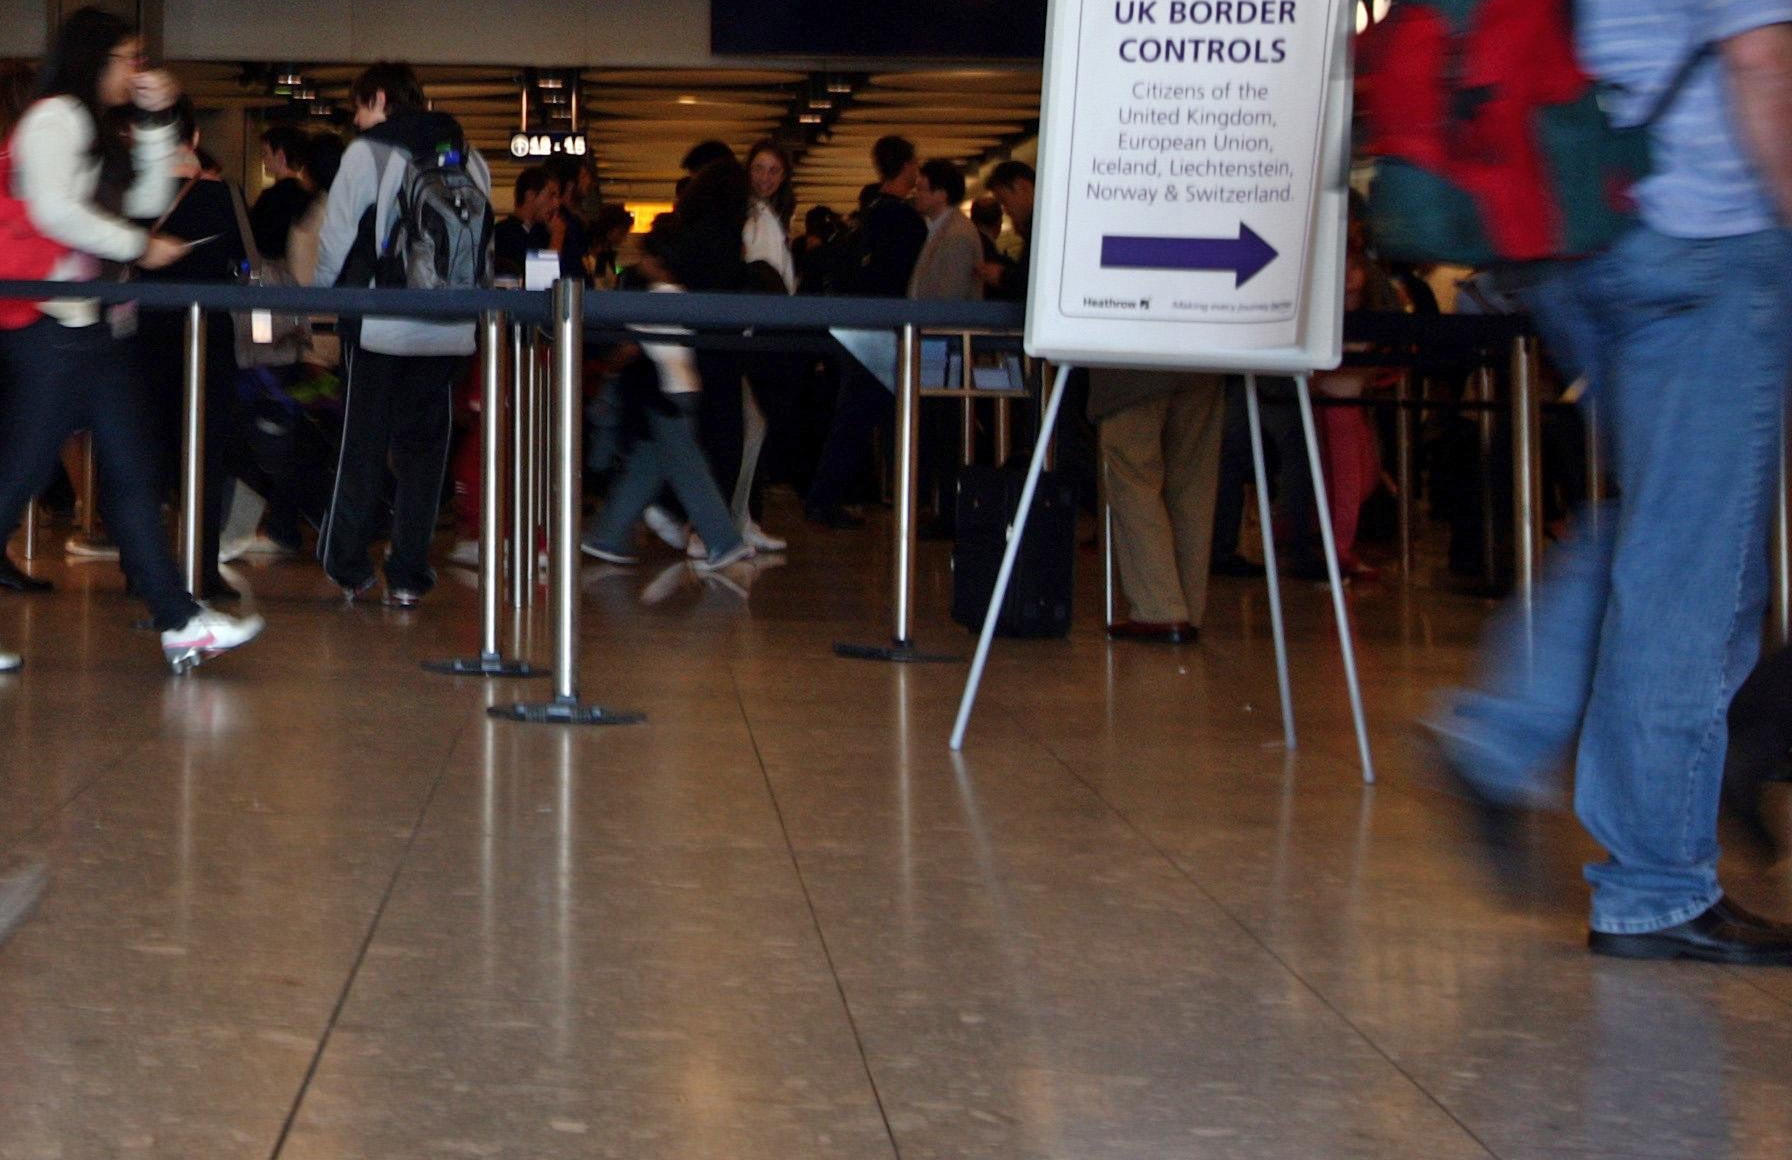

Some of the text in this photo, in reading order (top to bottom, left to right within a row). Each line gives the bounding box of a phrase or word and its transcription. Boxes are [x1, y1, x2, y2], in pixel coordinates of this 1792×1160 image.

[1115, 0, 1296, 24] UK BORDER
[1119, 38, 1286, 63] CONTROLS
[1132, 81, 1268, 101] Citizens of the
[1119, 107, 1277, 129] United Kingdom,
[1118, 133, 1273, 154] European Union,
[1092, 157, 1294, 179] Iceland, Liechtenstein,
[1087, 183, 1294, 205] Norway & Switzerland.
[1083, 297, 1136, 310] Heathrow
